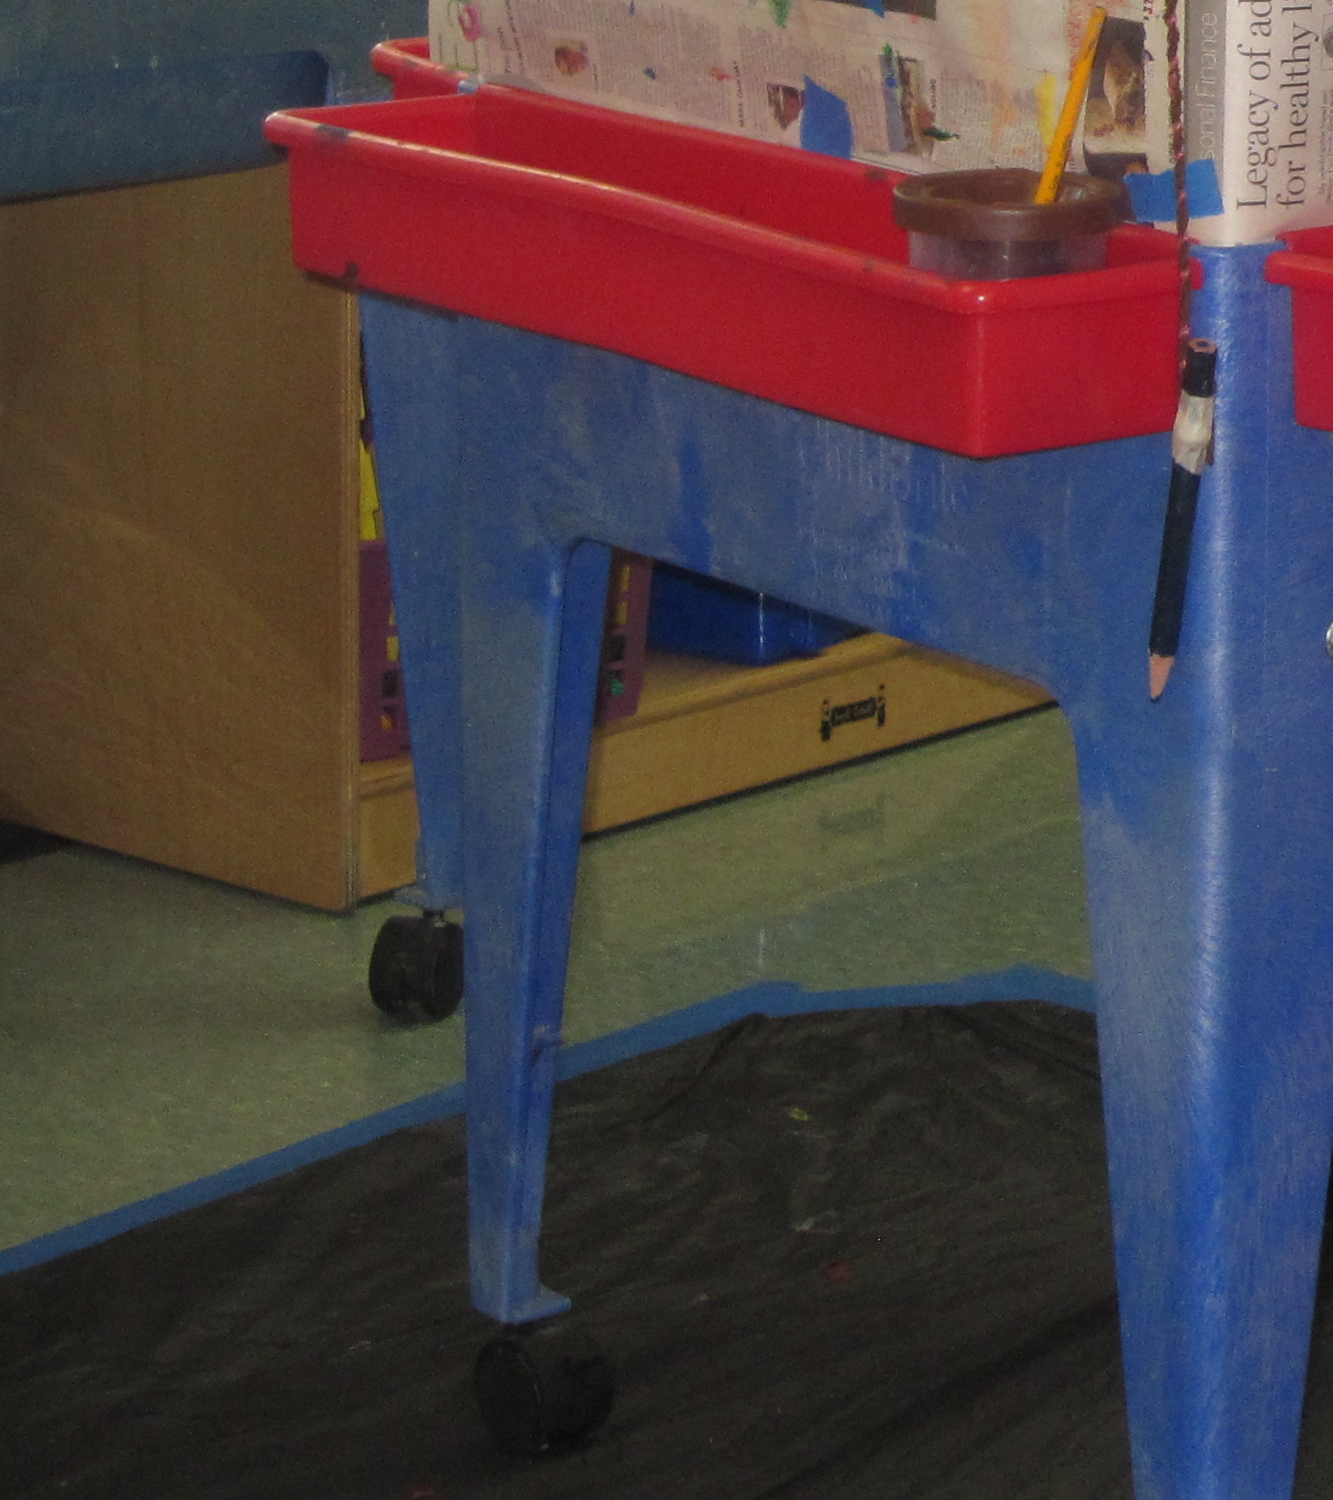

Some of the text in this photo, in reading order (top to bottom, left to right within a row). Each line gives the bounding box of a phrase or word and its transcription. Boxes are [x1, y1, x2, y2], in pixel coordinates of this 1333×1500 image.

[1195, 12, 1219, 96] Finance
[1236, 43, 1272, 81] of
[1277, 22, 1320, 151] healthy
[1235, 90, 1279, 210] Legacy
[1275, 160, 1307, 210] for
